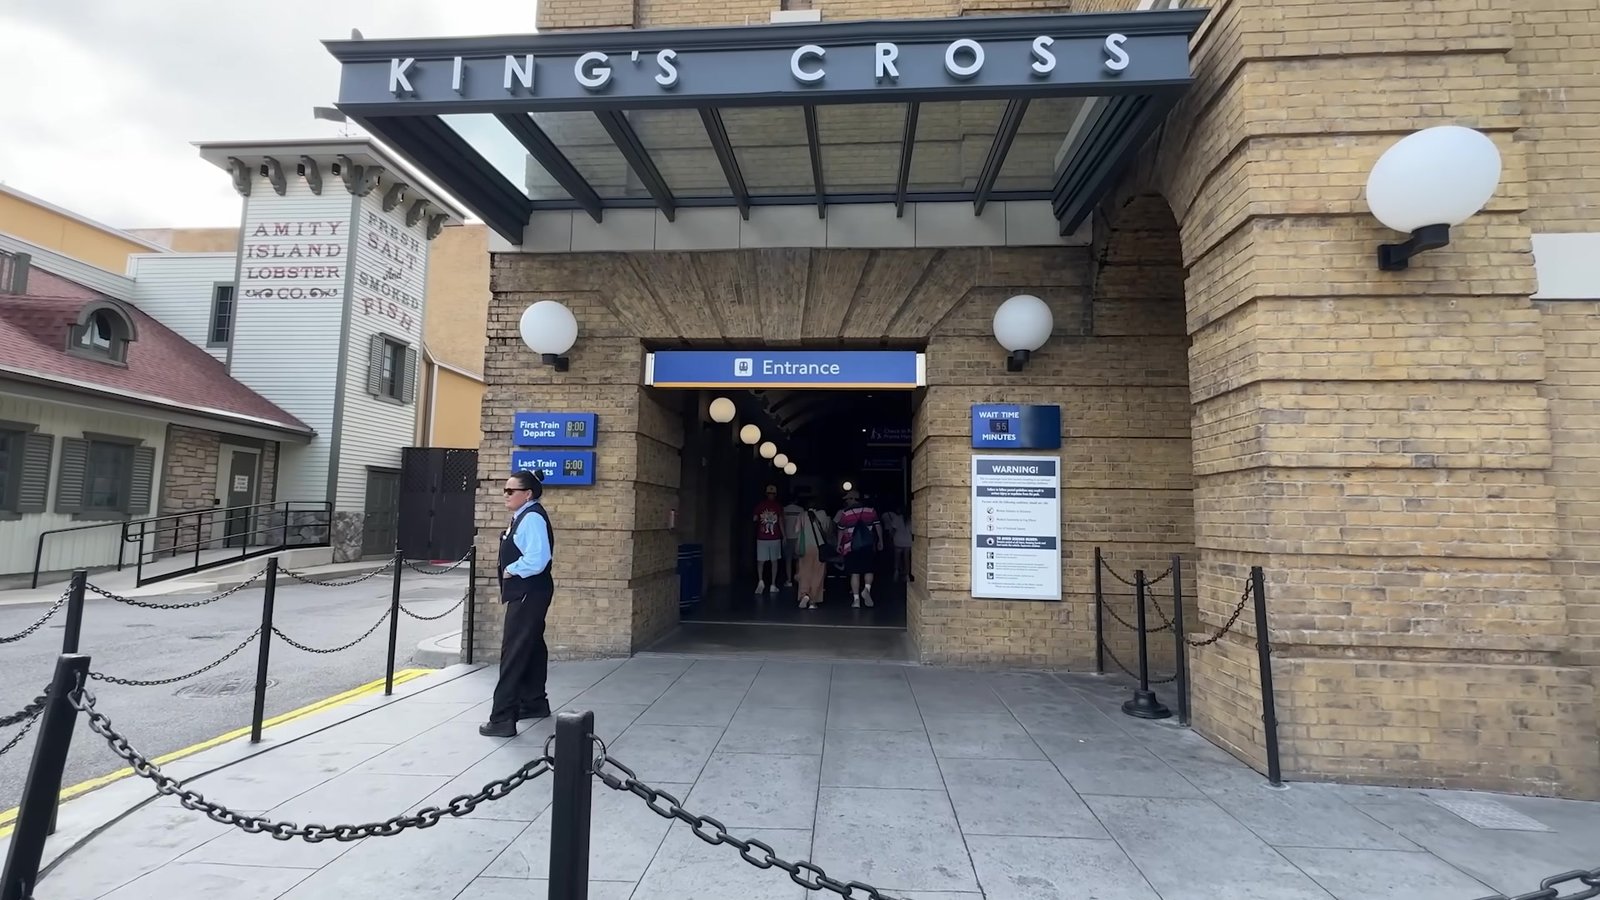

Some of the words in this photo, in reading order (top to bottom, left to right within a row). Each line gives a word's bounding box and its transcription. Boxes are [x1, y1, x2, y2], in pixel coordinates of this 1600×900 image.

[389, 49, 679, 93] KING'S
[791, 33, 1130, 82] CROSS
[252, 222, 342, 237] AMITY
[367, 211, 420, 253] FRESH
[246, 244, 341, 258] ISLAND
[367, 231, 417, 270] SALT
[246, 266, 340, 279] LOBSTER
[382, 267, 403, 280] And
[277, 287, 307, 300] CO.
[359, 271, 419, 310] SMOKED
[361, 297, 414, 333] FISH
[763, 359, 840, 375] Entrance
[979, 411, 998, 419] WAIT
[1001, 411, 1020, 419] TIME
[520, 421, 539, 429] First
[540, 421, 560, 429] Train
[523, 429, 556, 438] Departs
[982, 433, 1017, 441] MINUTES
[518, 459, 536, 467] Last
[537, 459, 557, 467] Train
[992, 465, 1039, 474] WARNING!
